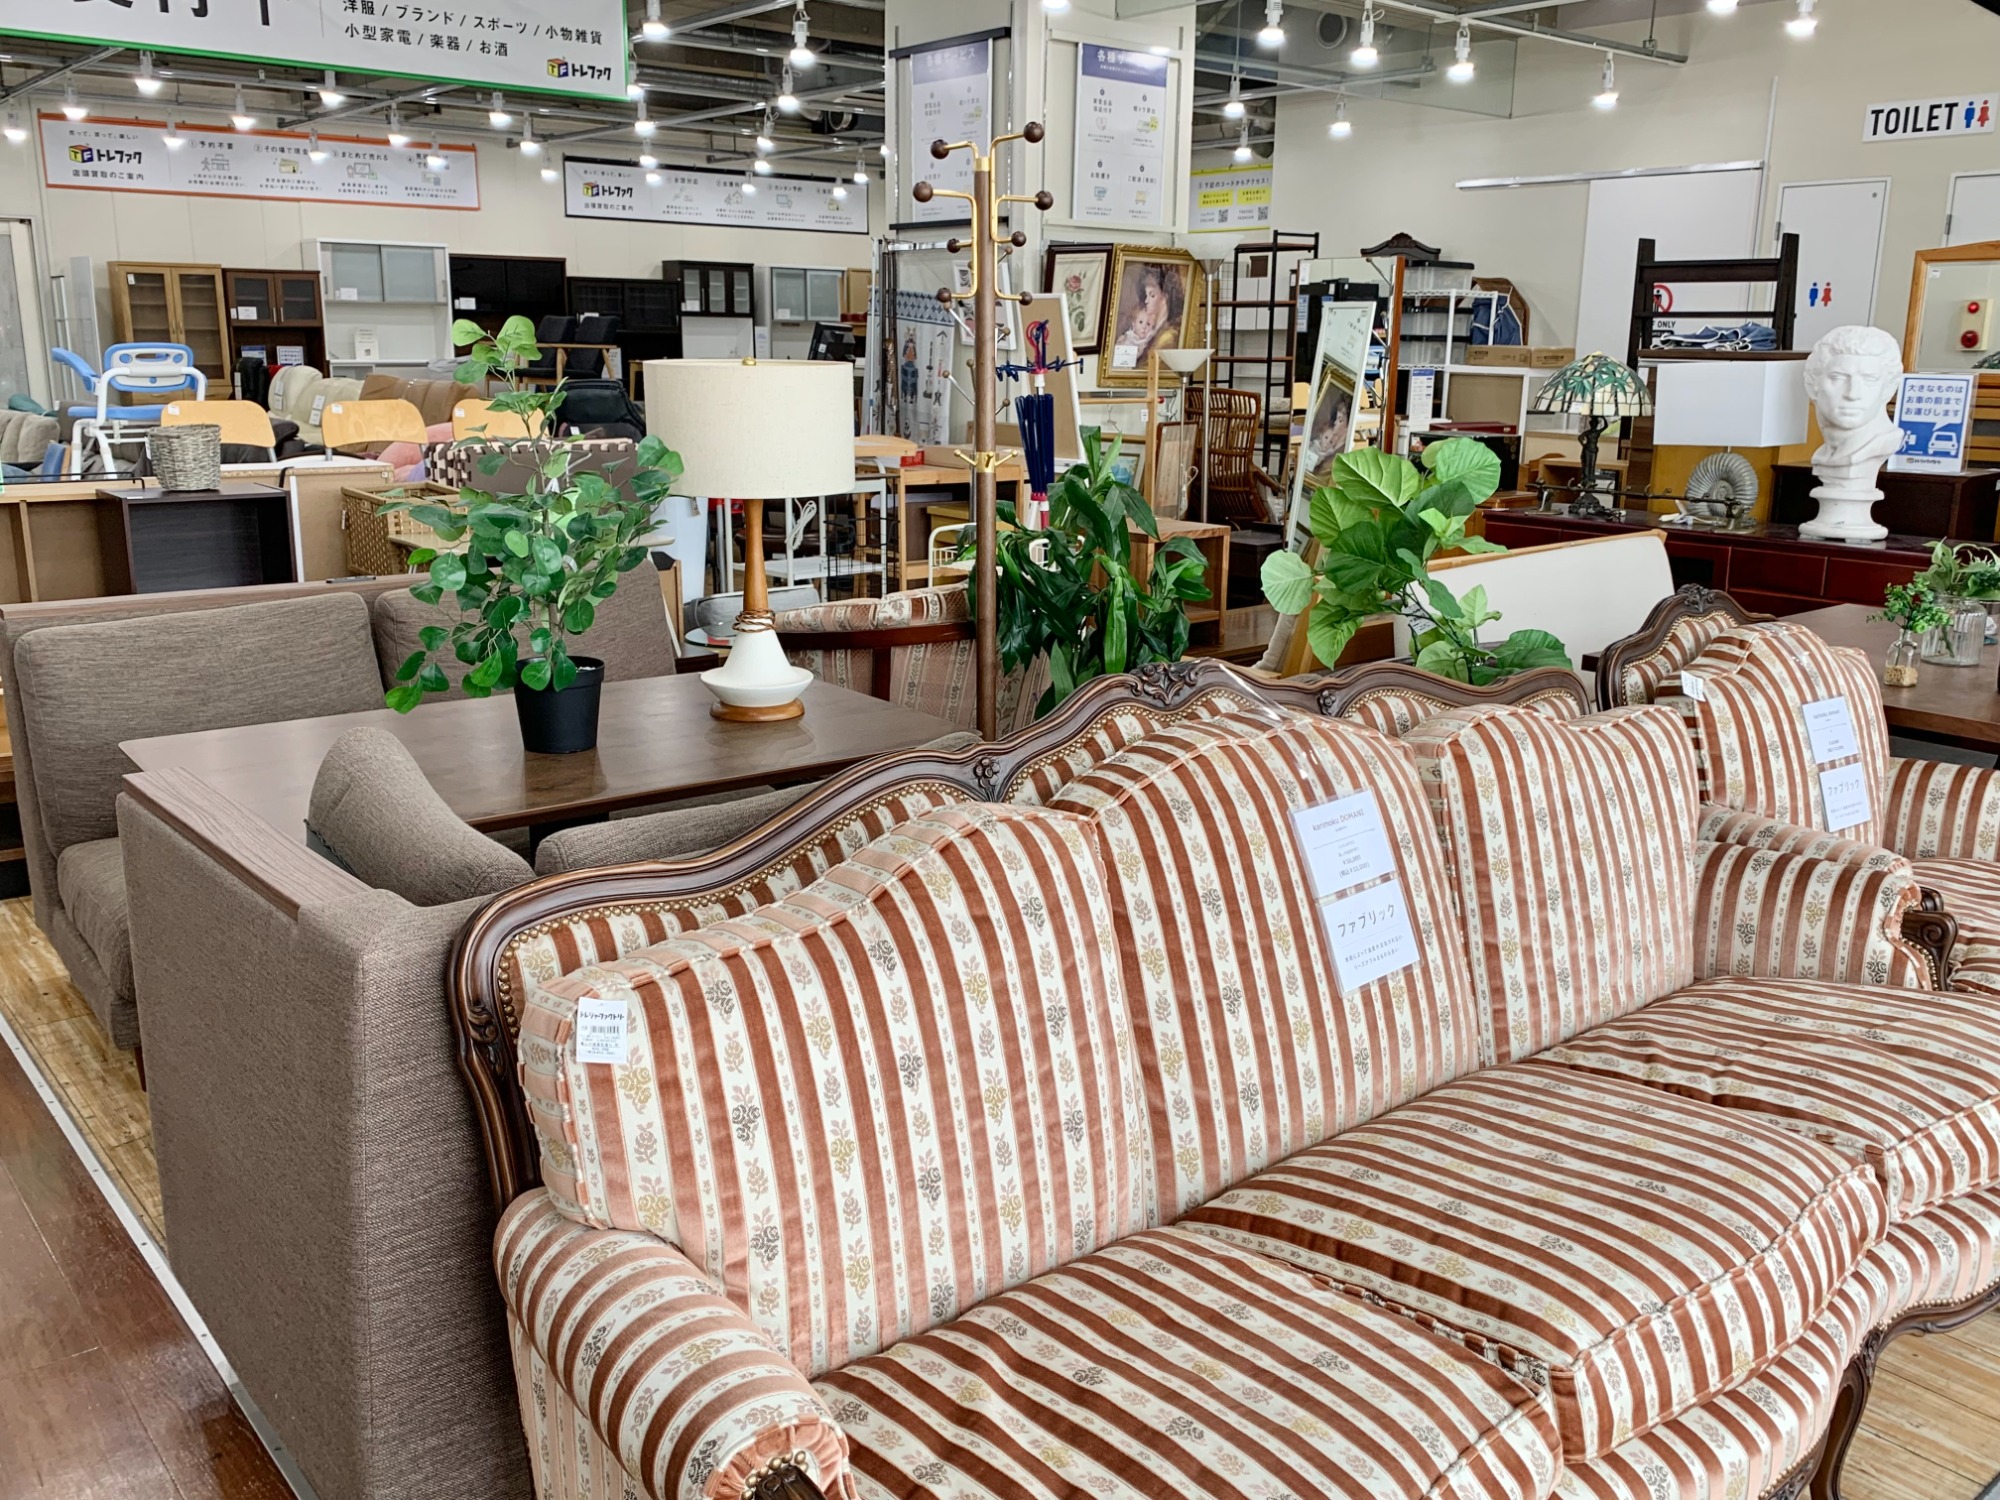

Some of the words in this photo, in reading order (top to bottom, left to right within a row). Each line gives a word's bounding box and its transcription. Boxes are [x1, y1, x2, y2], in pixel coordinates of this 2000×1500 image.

[396, 5, 454, 26] ブランド
[474, 15, 528, 34] スポーツ
[545, 25, 603, 46] 小物雑貨
[345, 23, 411, 46] 小型家電
[430, 34, 461, 51] 楽器
[479, 40, 508, 57] お酒
[572, 62, 611, 81] トレファク
[1870, 101, 1960, 137] TOILET
[96, 148, 142, 165] トレファク
[602, 185, 633, 198] トレファク
[1657, 320, 1676, 329] ONLY
[1908, 384, 1964, 394] 大きなものは
[1905, 395, 1962, 406] お車の前まで
[1904, 407, 1961, 418] お運びします
[1337, 903, 1396, 938] ファブリック
